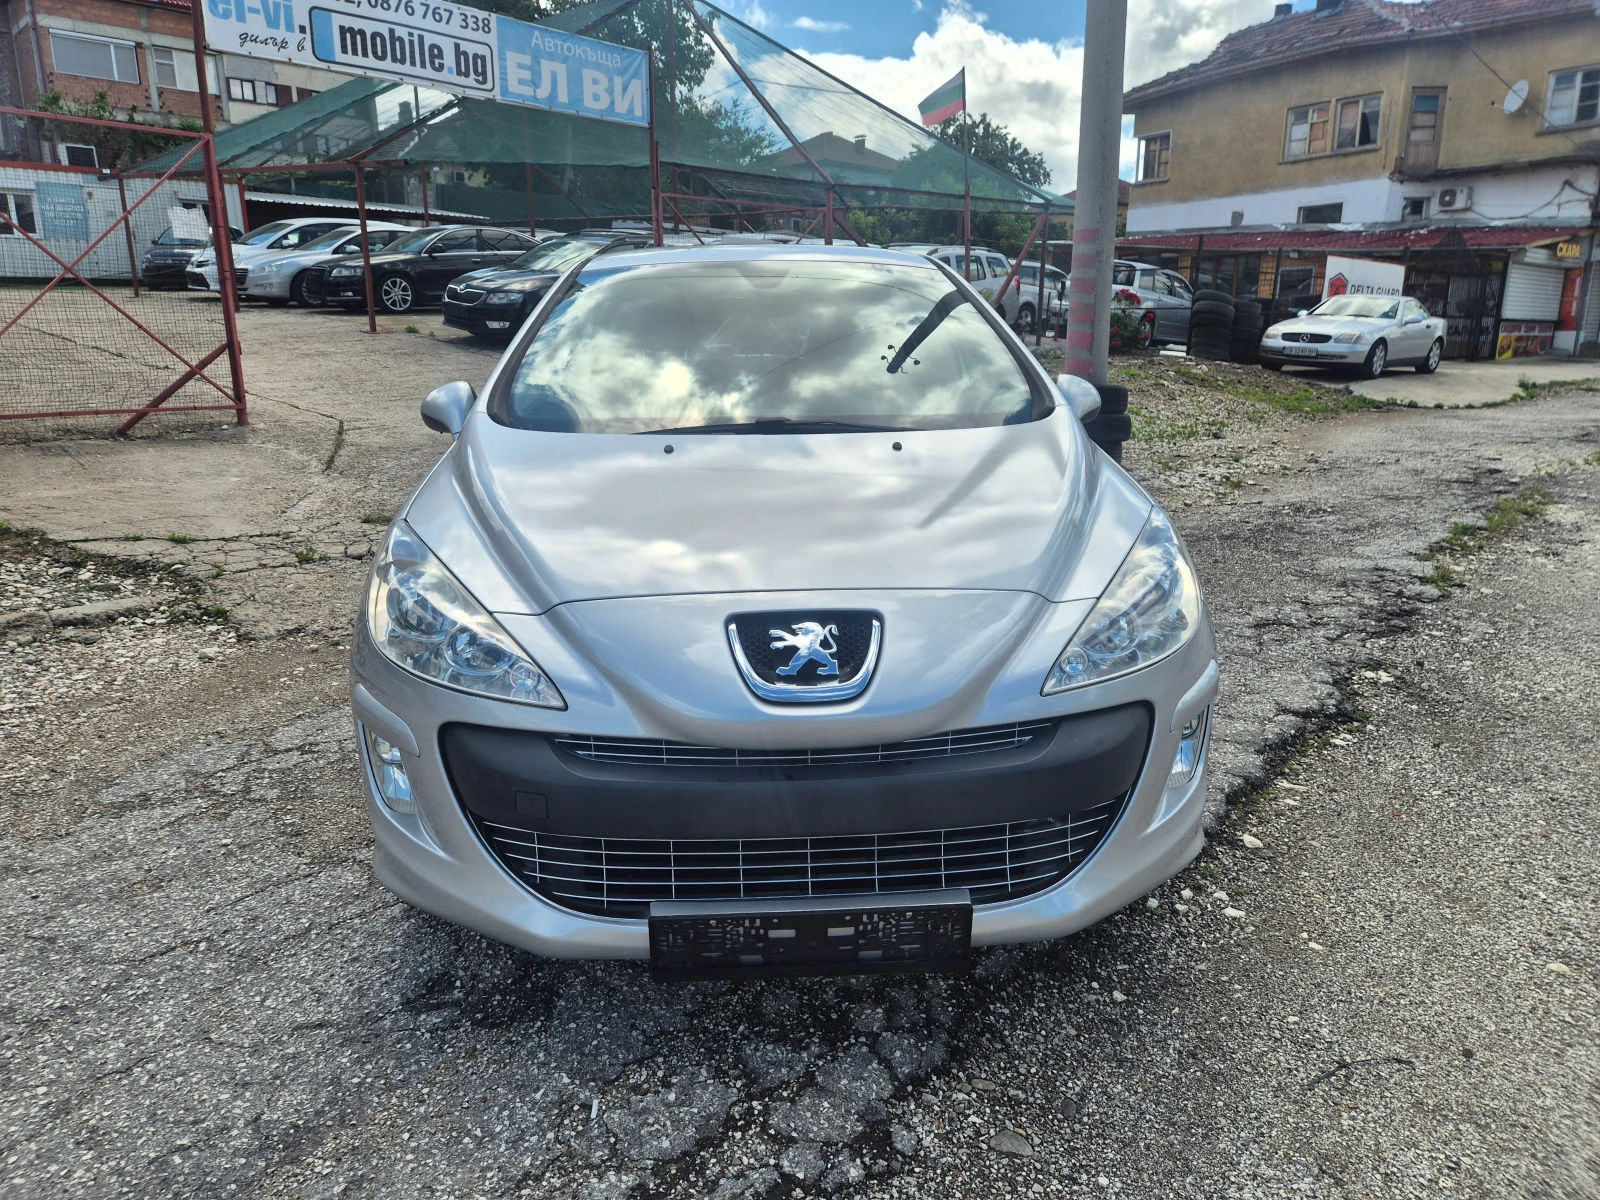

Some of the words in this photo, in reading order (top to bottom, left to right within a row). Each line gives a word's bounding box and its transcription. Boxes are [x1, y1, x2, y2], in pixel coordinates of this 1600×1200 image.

[419, 2, 454, 26] 767
[459, 12, 492, 35] 338
[238, 32, 290, 52] дилър
[338, 24, 488, 86] mobile.bg
[530, 30, 622, 68] Автокъща
[505, 50, 569, 104] ЕЛ
[582, 68, 643, 117] ВИ
[1557, 242, 1580, 258] СКАРА
